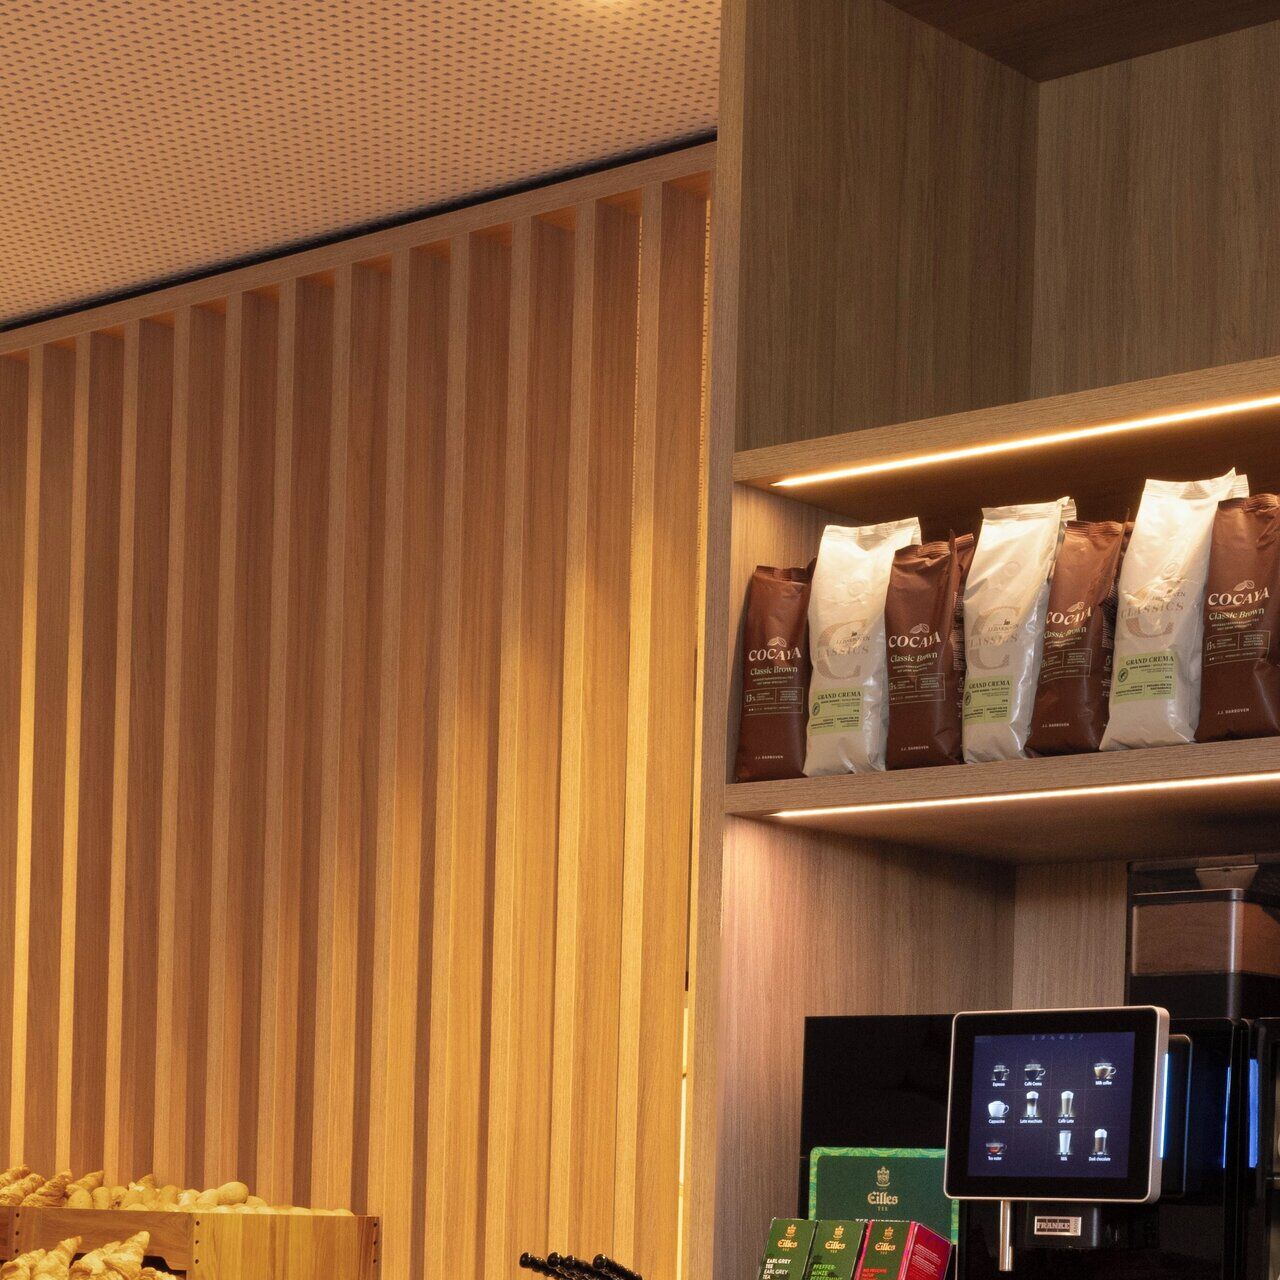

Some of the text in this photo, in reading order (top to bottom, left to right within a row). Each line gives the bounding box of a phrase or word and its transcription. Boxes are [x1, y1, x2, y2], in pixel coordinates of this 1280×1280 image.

[1207, 586, 1270, 606] COCAYA
[1208, 607, 1265, 621] Classic Brown
[888, 631, 942, 648] COCAYA
[748, 646, 802, 662] COCAYA
[890, 651, 938, 663] Classic Brown
[1126, 655, 1174, 666] GRAND CREMA
[750, 665, 798, 676] Classic Brown
[968, 681, 987, 689] GRAND
[817, 690, 861, 700] GRAND CREMA
[867, 1191, 899, 1205] Eilles
[777, 1239, 798, 1248] Eilles
[825, 1240, 846, 1250] Eilles
[874, 1242, 896, 1251] Eilles
